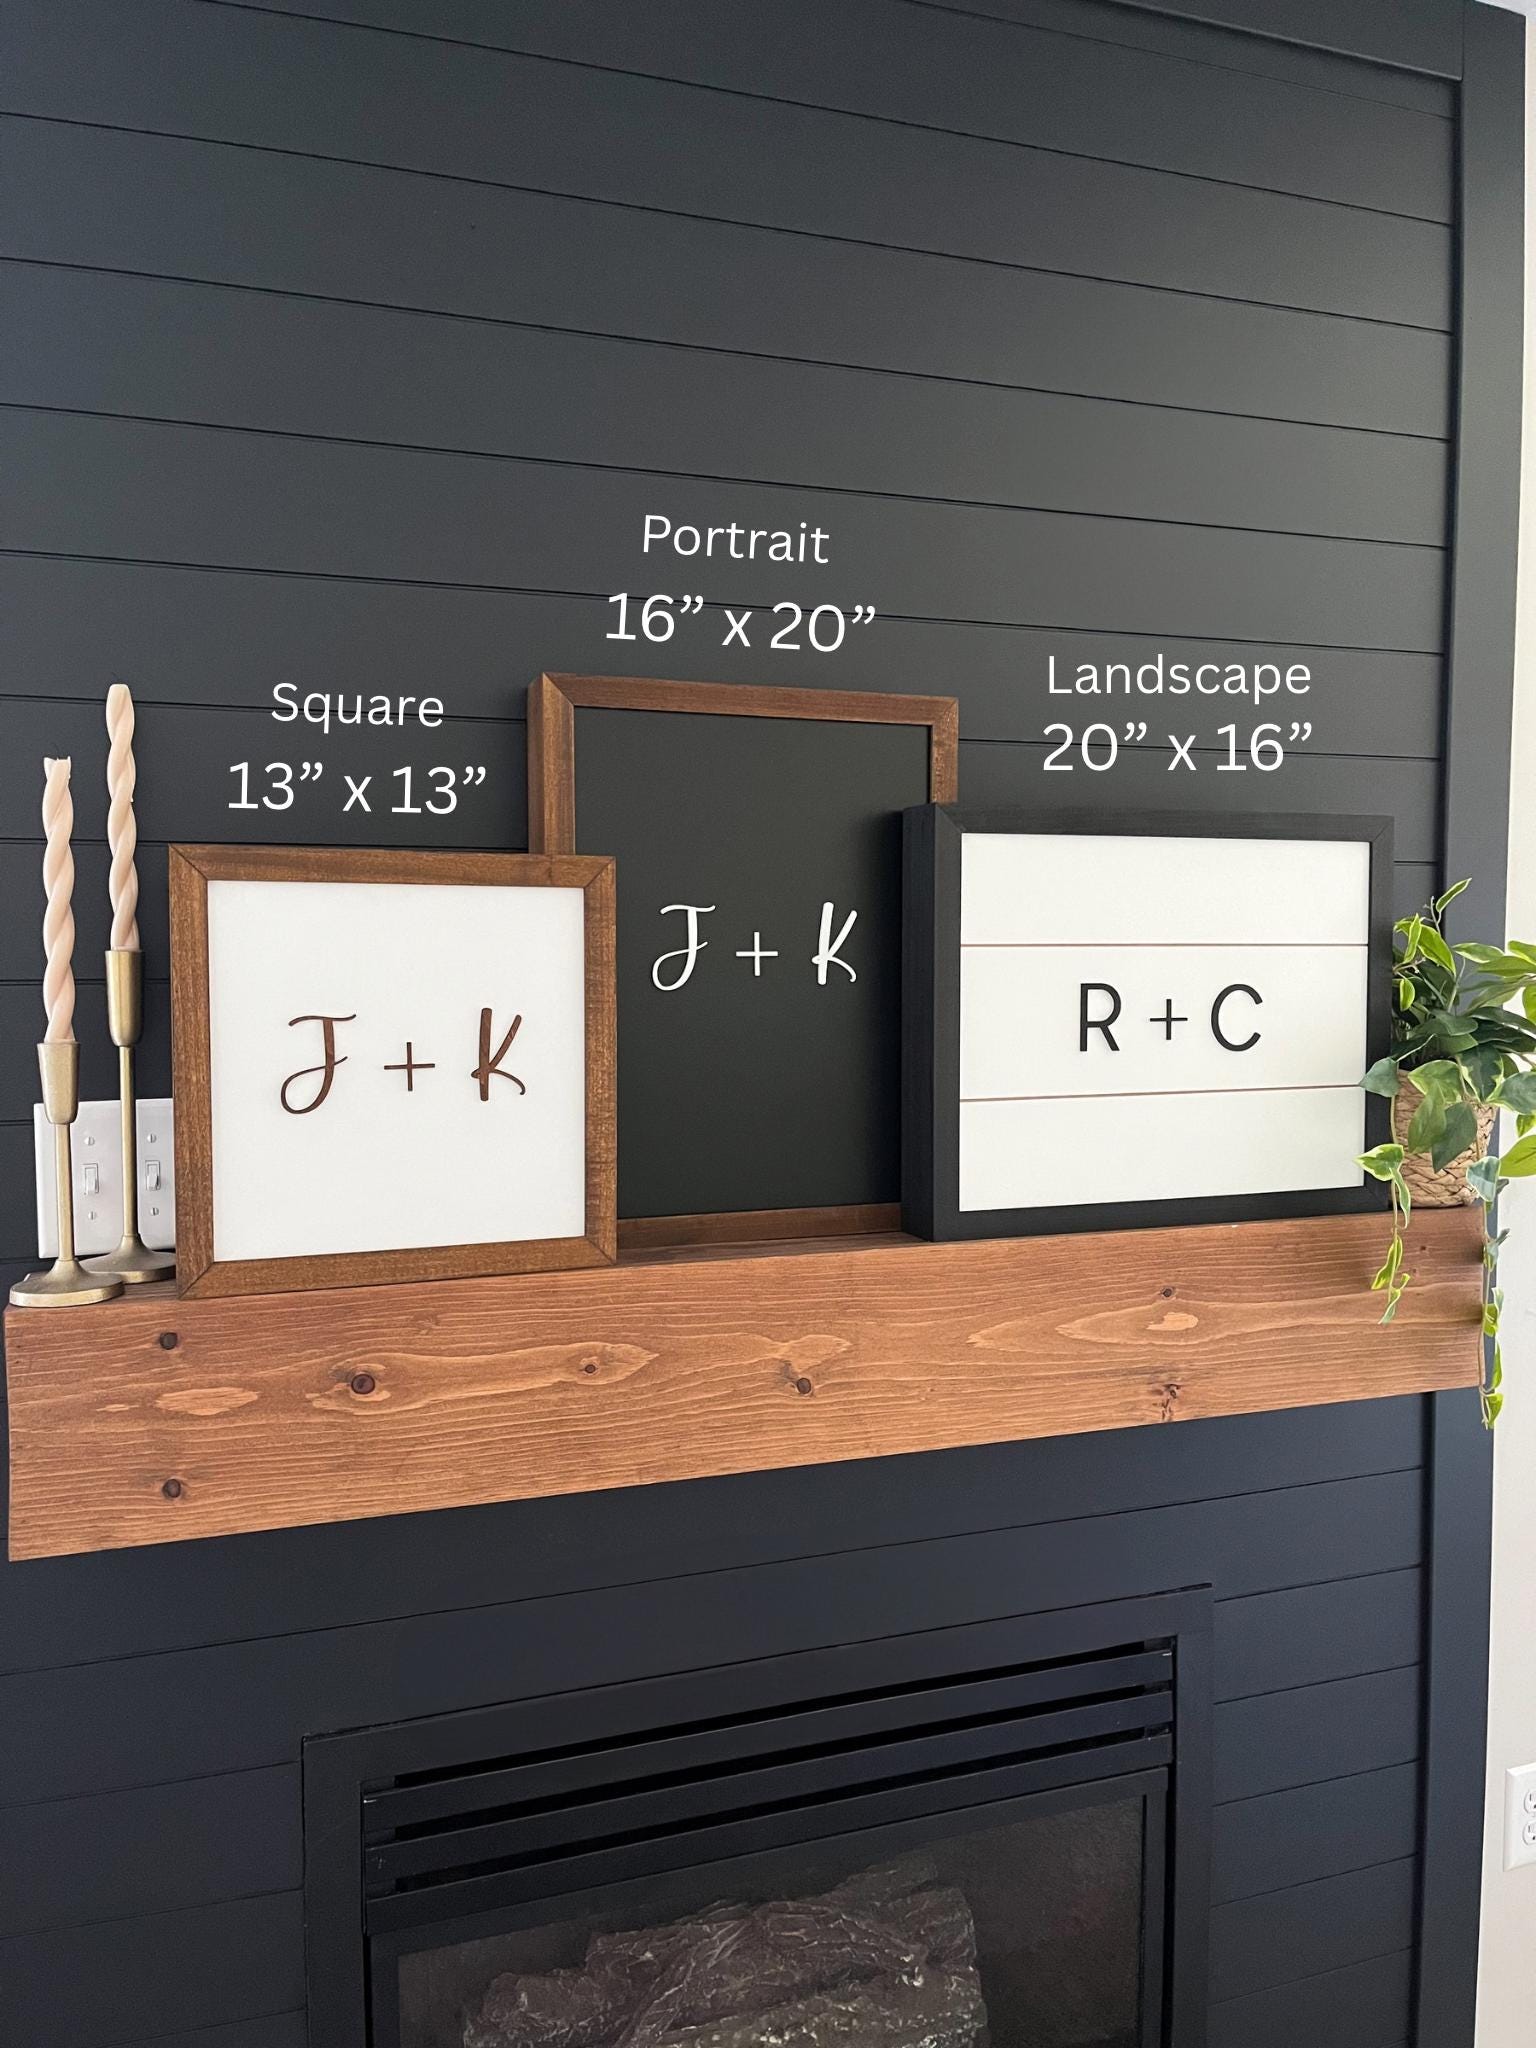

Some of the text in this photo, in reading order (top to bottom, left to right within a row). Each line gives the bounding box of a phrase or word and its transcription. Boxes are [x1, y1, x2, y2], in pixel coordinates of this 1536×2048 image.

[651, 901, 859, 992] J + K
[279, 1006, 527, 1116] J + K
[1078, 982, 1264, 1053] R + C
